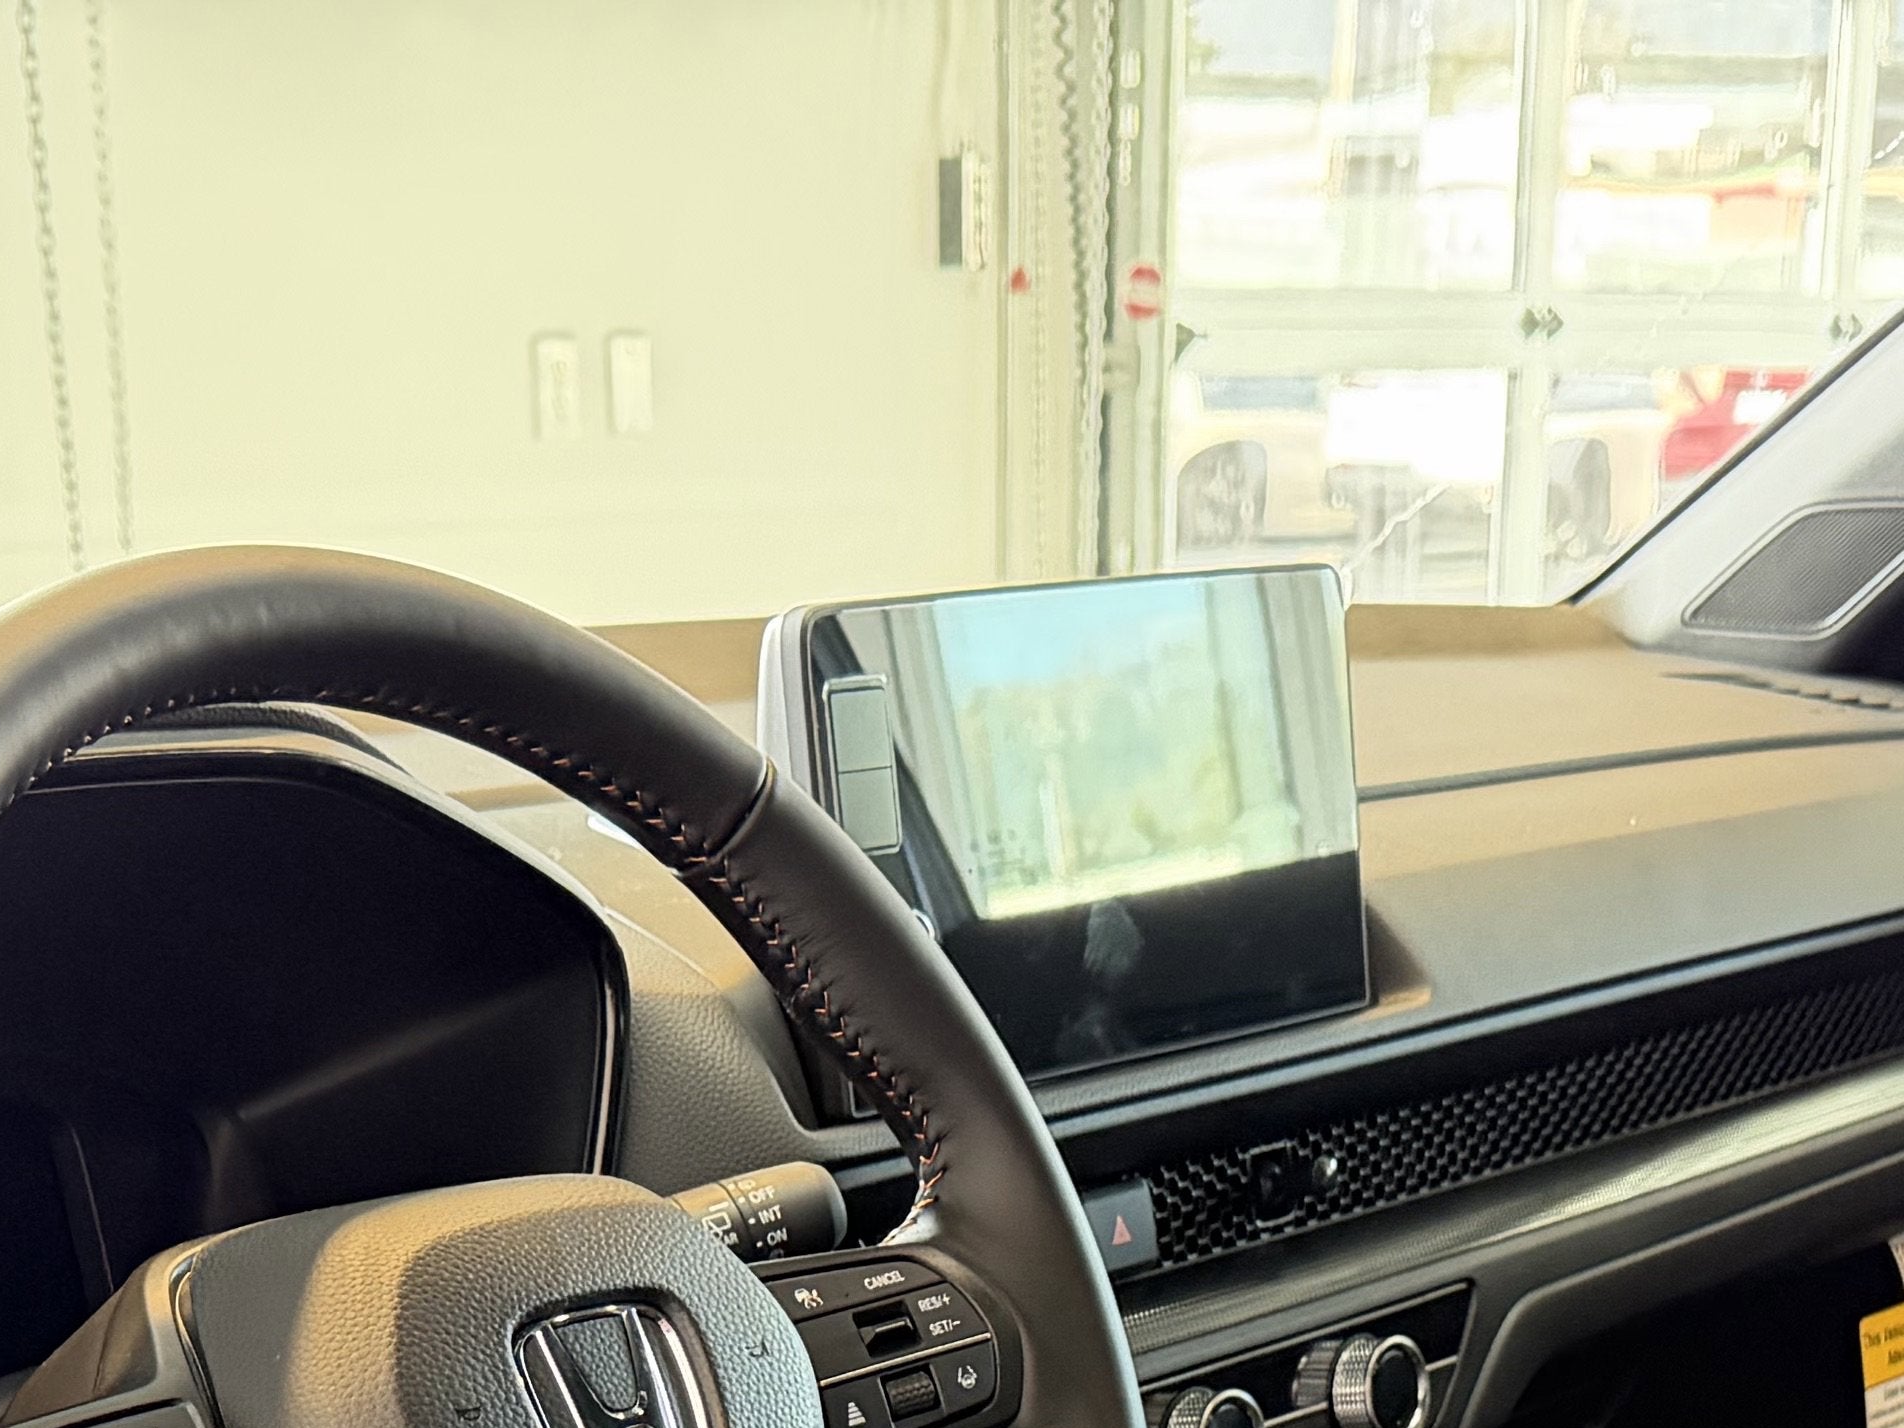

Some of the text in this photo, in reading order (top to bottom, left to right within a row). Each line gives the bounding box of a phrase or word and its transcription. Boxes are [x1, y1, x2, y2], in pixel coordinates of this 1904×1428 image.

[748, 1185, 776, 1204] OFF
[758, 1204, 782, 1225] INT
[767, 1227, 788, 1246] ON
[863, 1270, 905, 1290] CANCEL
[917, 1293, 951, 1312] RES/+
